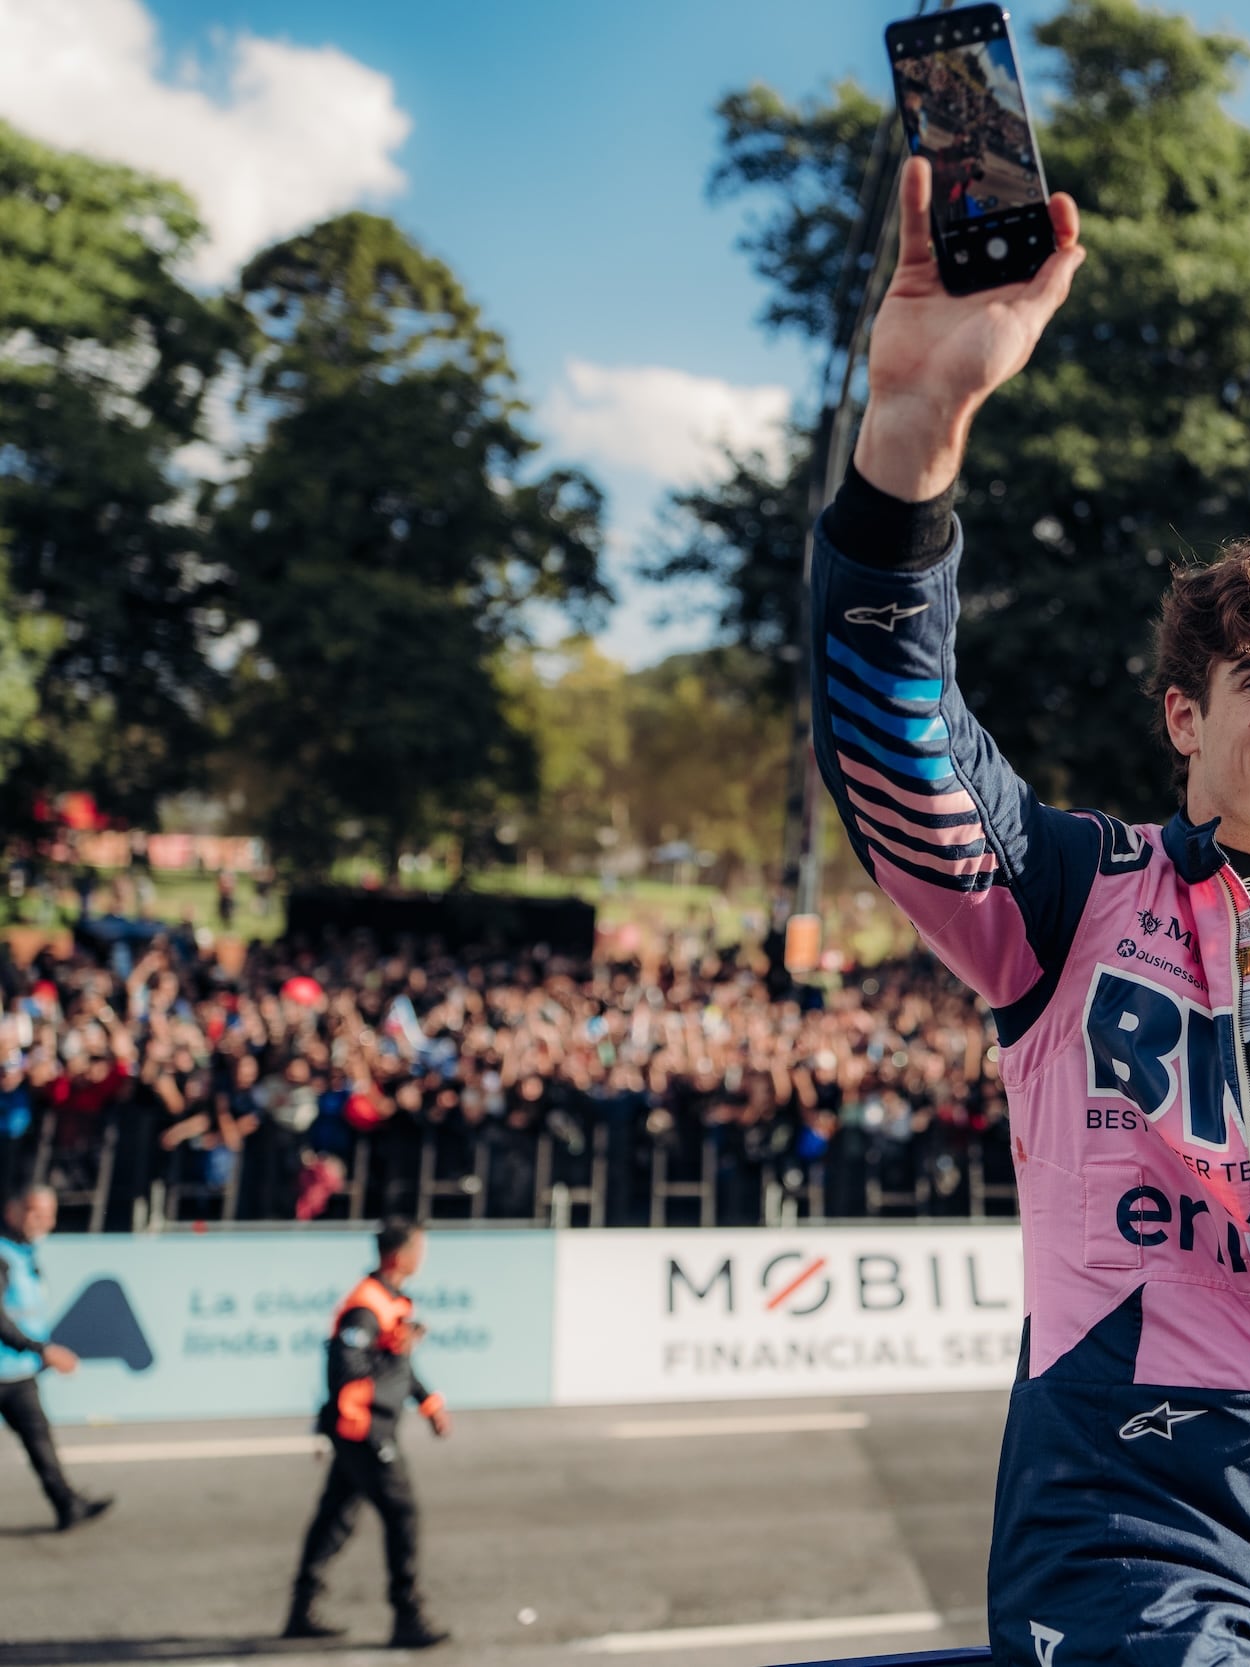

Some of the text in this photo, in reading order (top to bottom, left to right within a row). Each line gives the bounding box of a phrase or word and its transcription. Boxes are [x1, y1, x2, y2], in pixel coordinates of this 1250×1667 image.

[252, 1282, 344, 1315] ciud
[665, 1250, 1012, 1317] MOBIL
[290, 1325, 330, 1352] de
[662, 1335, 929, 1374] FINANCIAL
